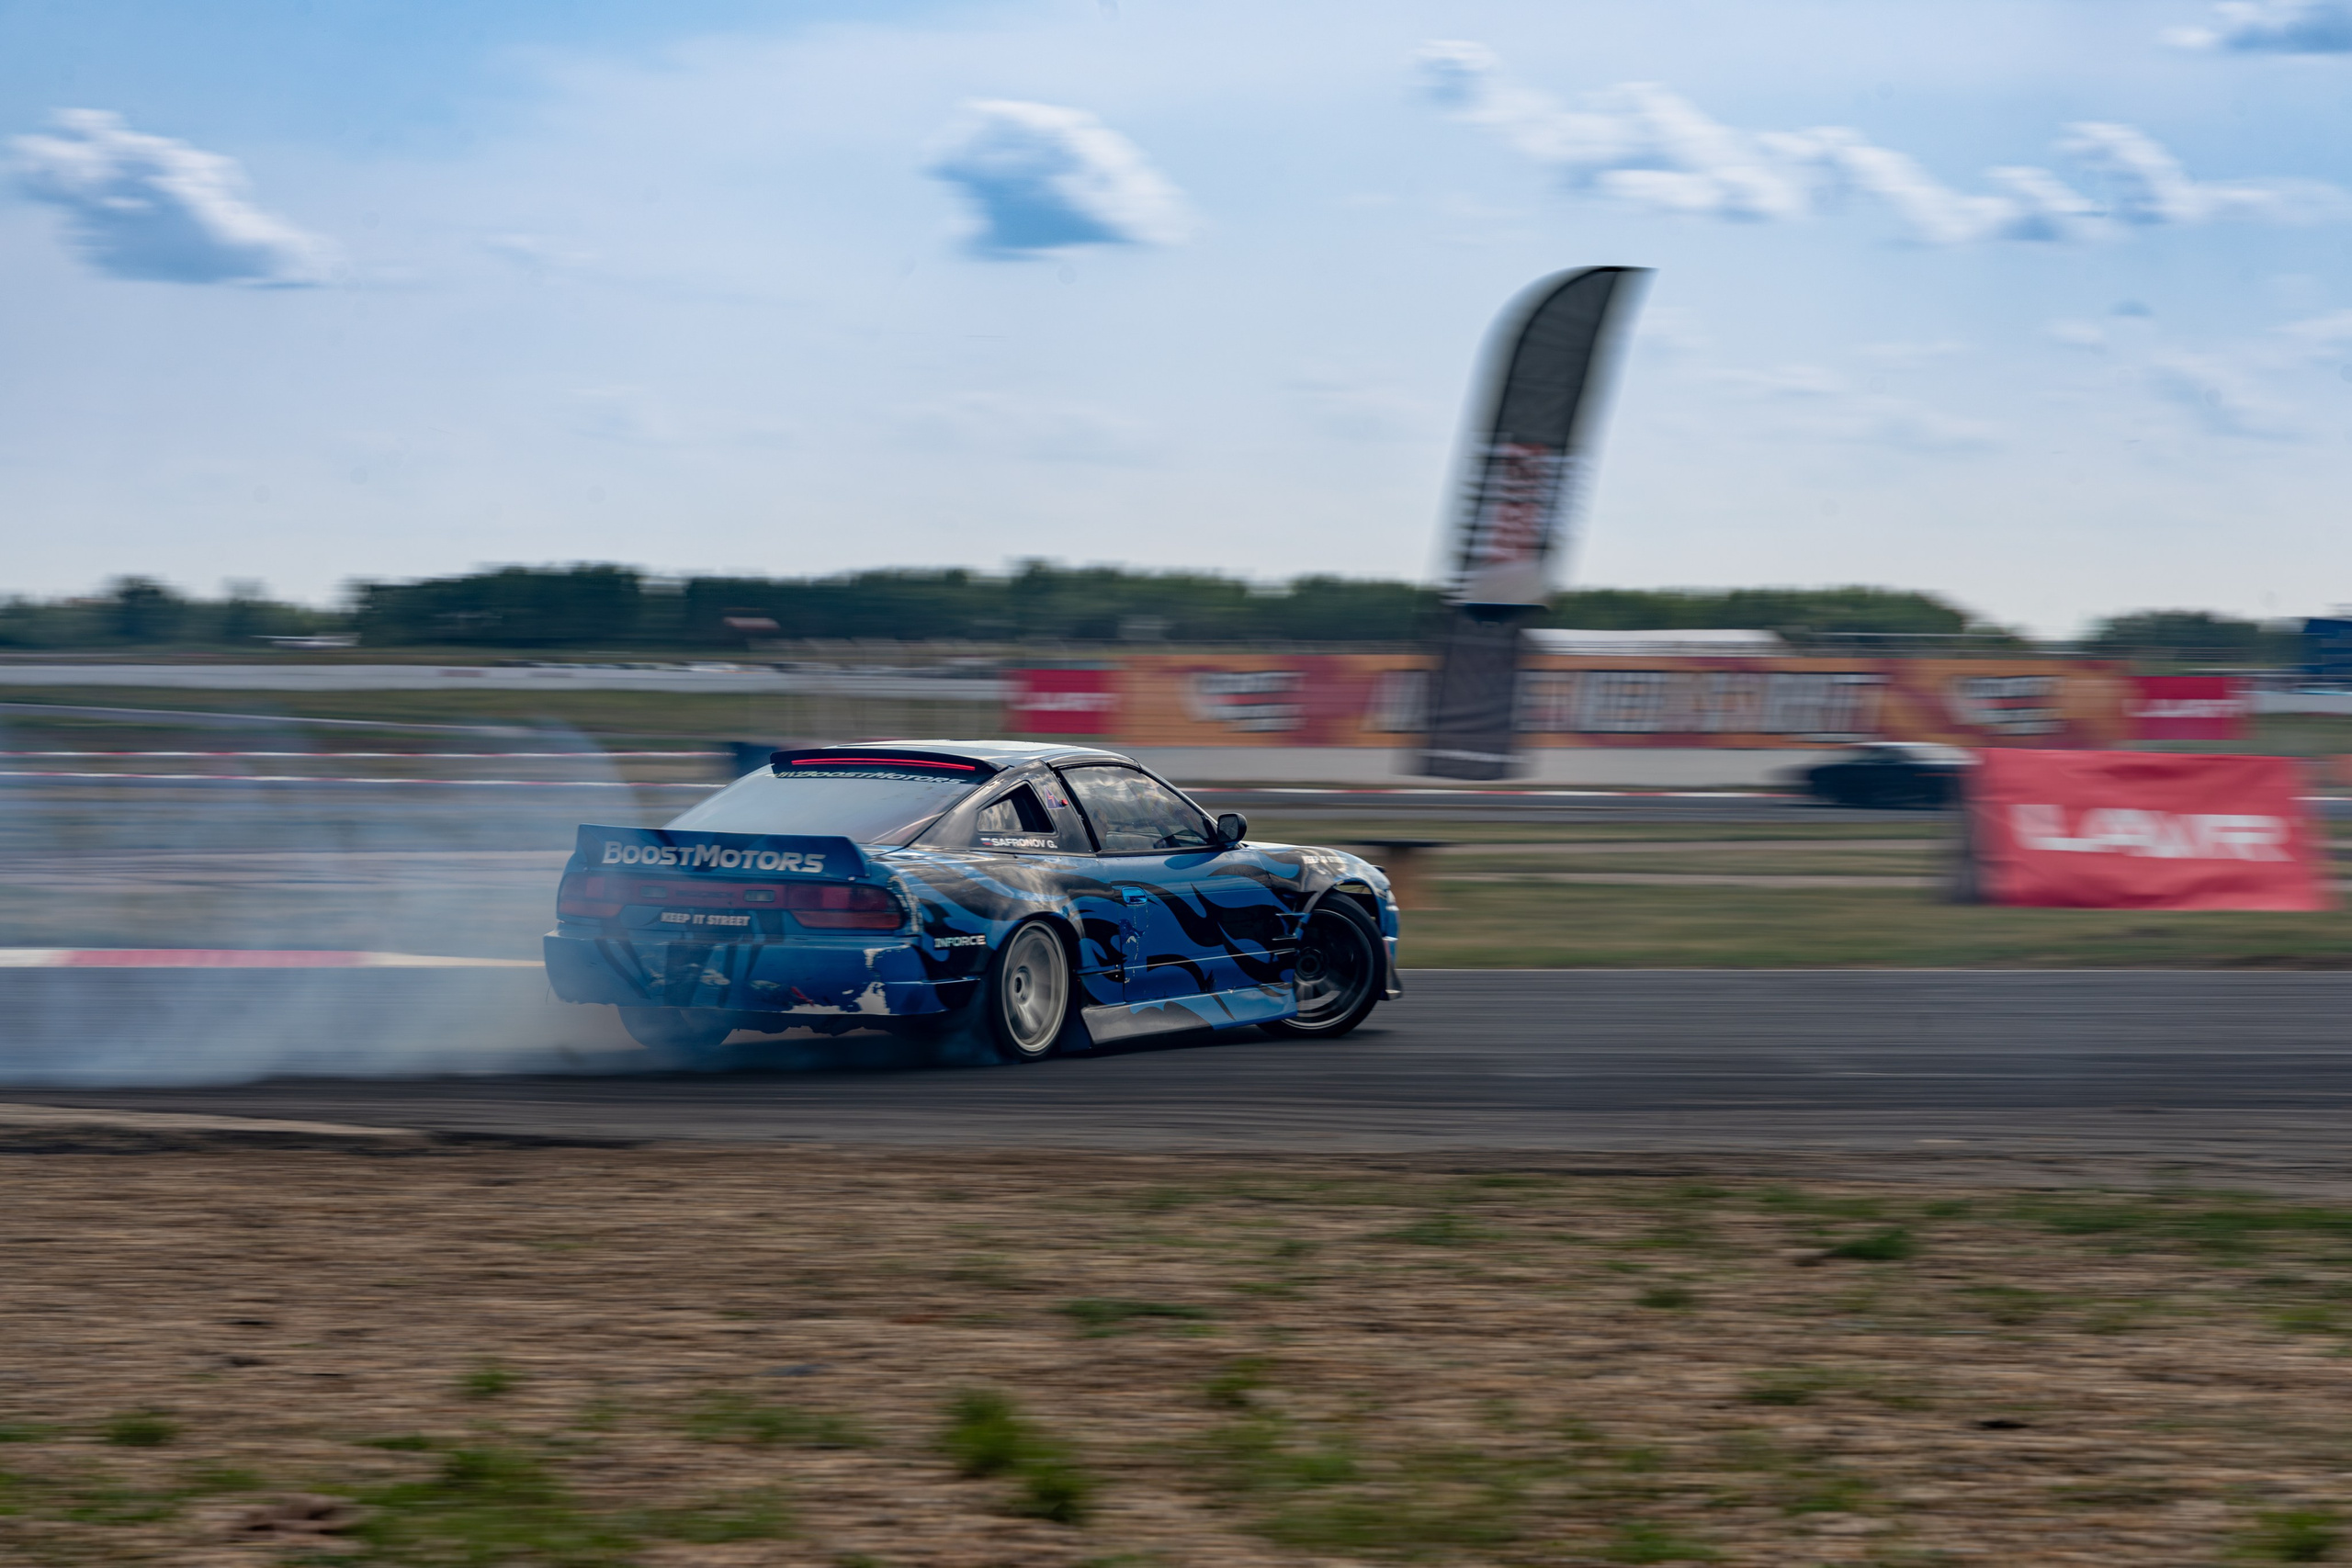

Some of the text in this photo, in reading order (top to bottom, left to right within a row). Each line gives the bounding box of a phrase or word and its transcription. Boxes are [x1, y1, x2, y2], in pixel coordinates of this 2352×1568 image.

[991, 838, 1058, 849] SAFRONOV G.
[660, 911, 751, 926] KEEP IT STREET
[934, 935, 986, 948] INFORCE
